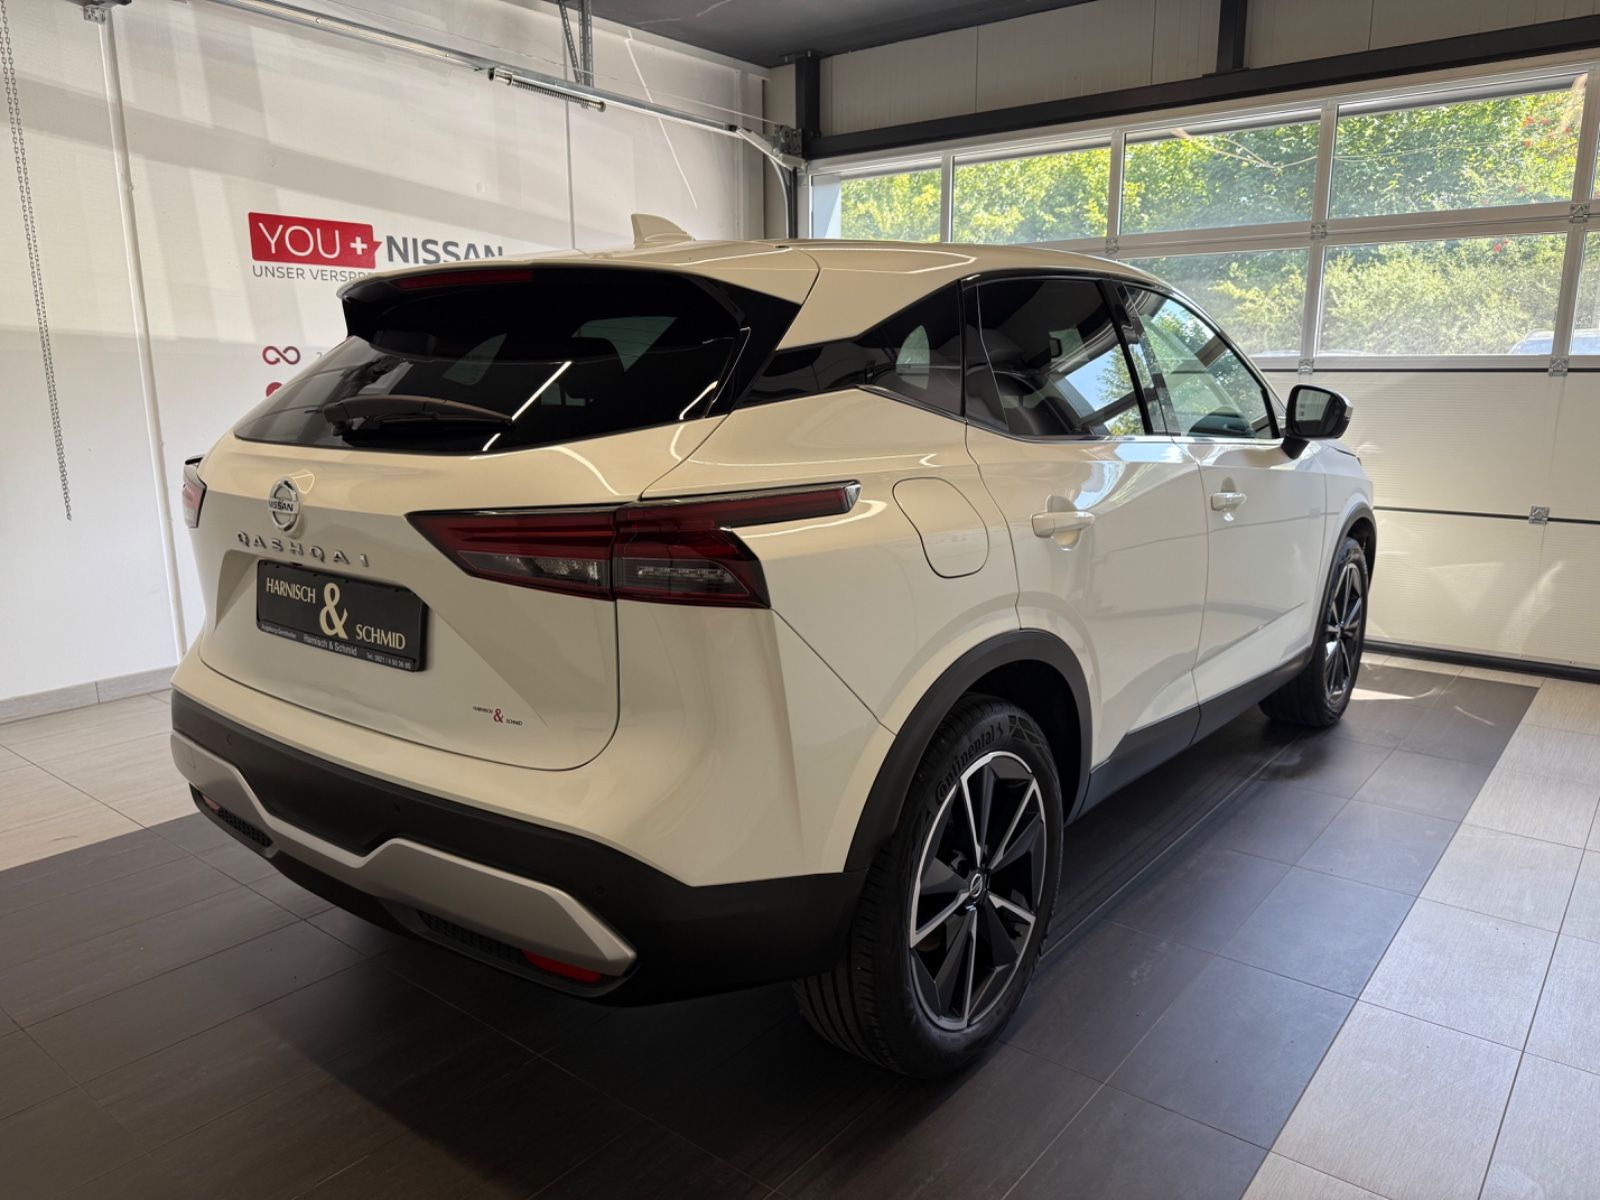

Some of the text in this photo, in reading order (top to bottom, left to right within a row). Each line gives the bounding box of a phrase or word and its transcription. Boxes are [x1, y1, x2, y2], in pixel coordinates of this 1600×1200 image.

[258, 222, 340, 259] YOU
[252, 265, 306, 280] UNSER
[237, 530, 370, 568] QASHQAI
[265, 577, 316, 604] HARNISCH
[319, 582, 349, 640] &
[355, 623, 406, 650] SCHMID
[334, 641, 358, 656] Schmid
[493, 708, 504, 723] &
[936, 724, 995, 806] Continental
